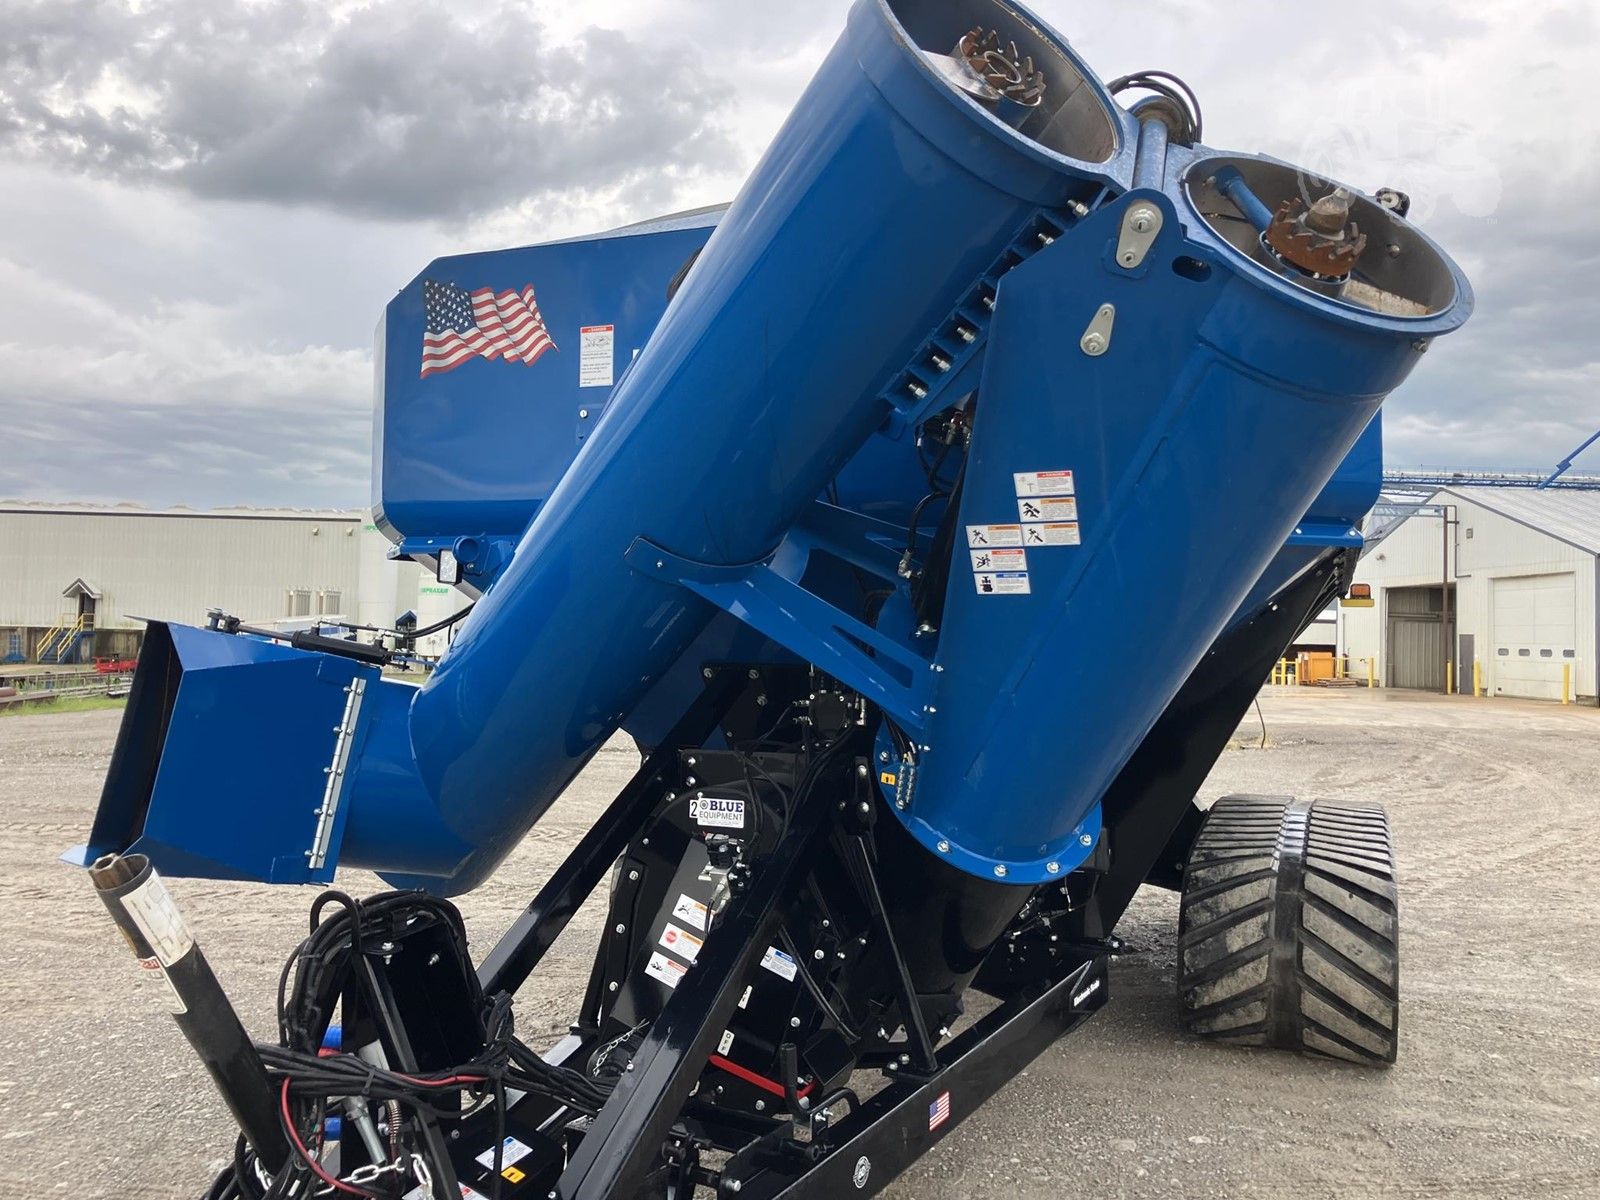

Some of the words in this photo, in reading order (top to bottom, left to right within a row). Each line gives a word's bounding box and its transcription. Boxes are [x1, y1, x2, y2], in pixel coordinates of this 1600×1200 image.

[690, 801, 698, 817] 2
[709, 800, 743, 812] BLUE
[700, 810, 743, 821] EQUIPMENT
